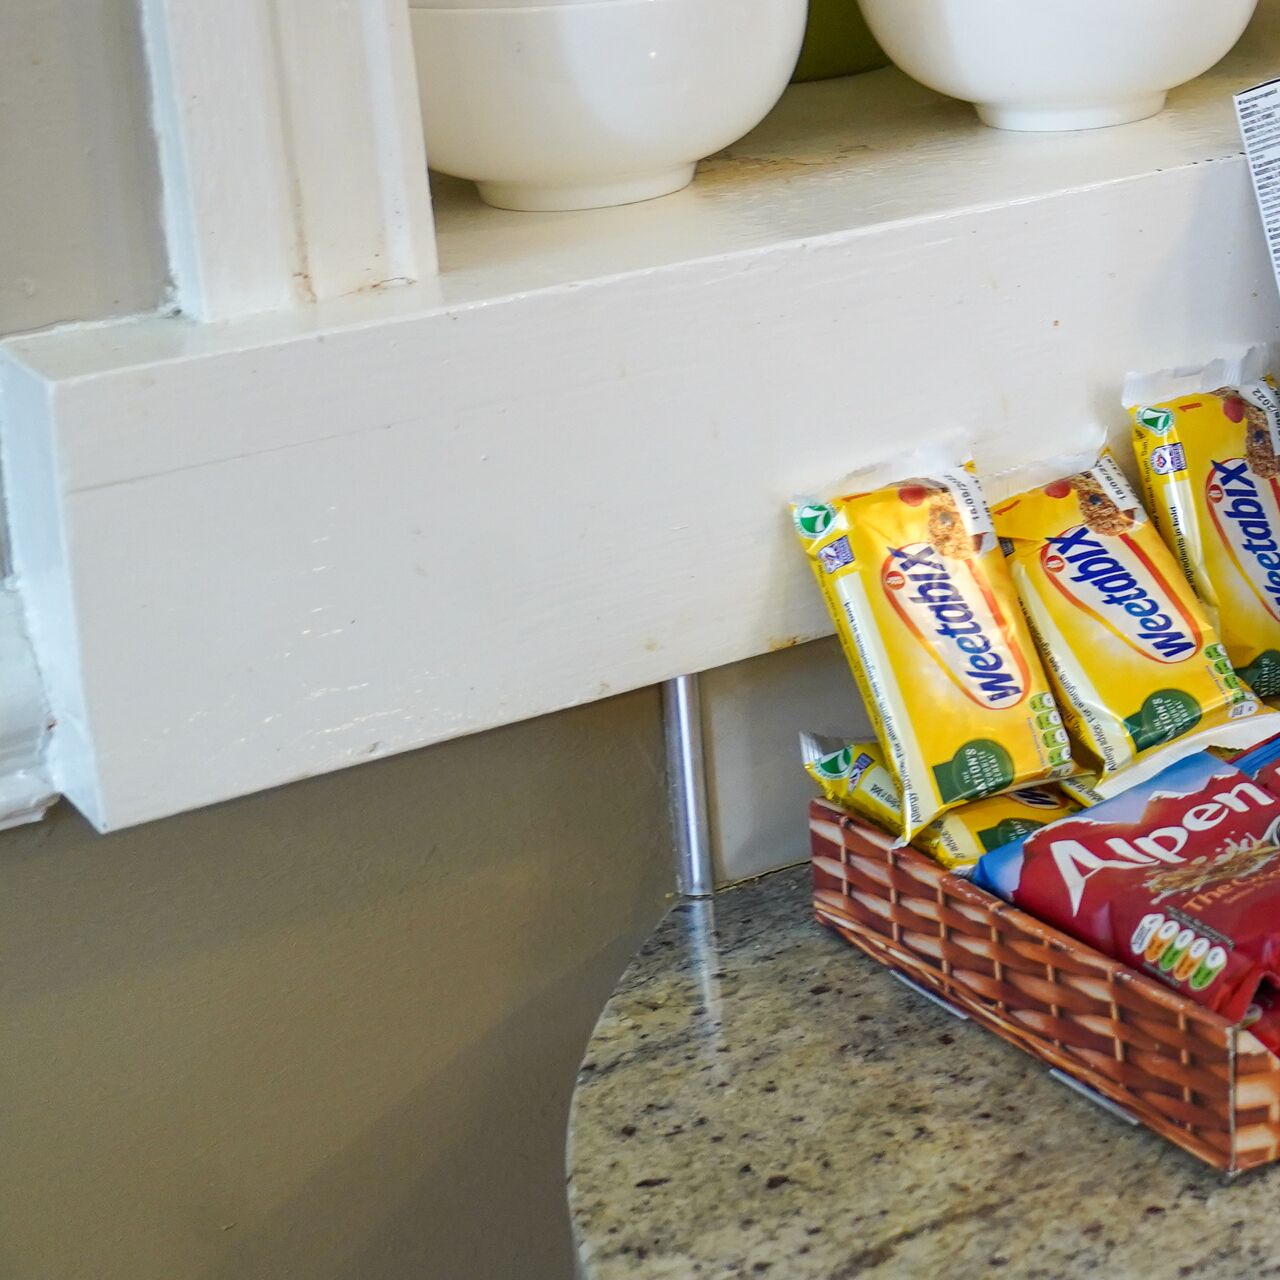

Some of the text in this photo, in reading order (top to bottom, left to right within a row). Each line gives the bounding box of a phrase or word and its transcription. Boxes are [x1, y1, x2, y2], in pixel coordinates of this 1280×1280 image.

[887, 544, 1023, 703] Weetabix
[1045, 526, 1197, 658] Weetabix
[1050, 782, 1275, 917] Alpen
[1181, 884, 1233, 912] The
